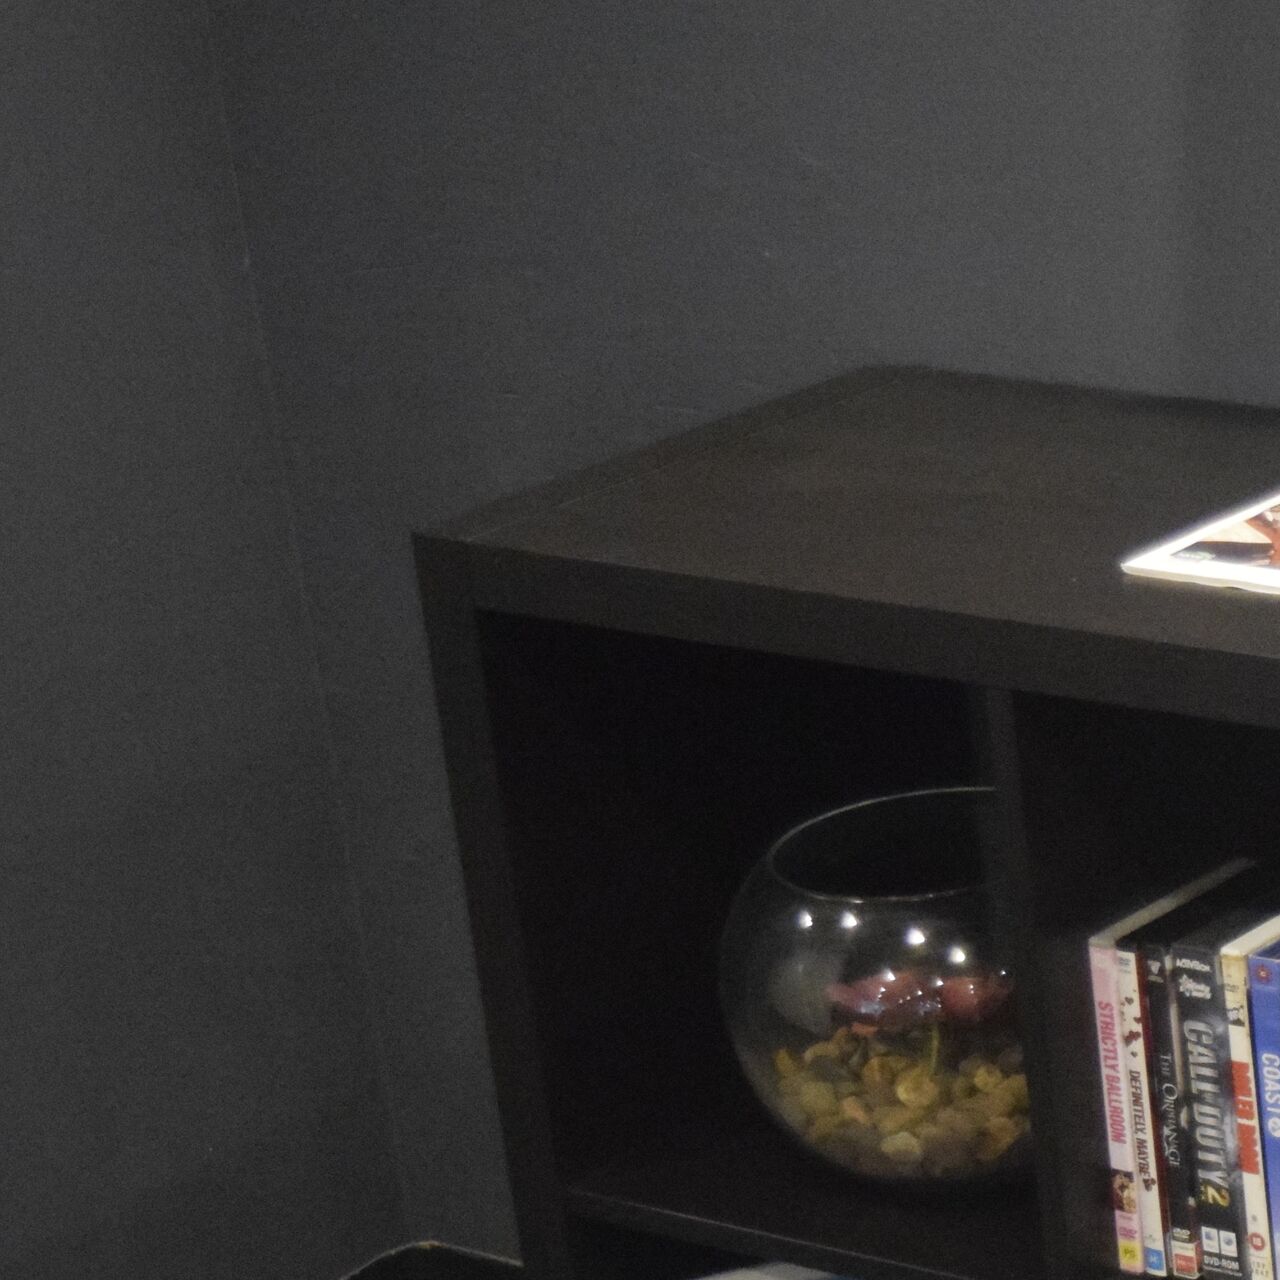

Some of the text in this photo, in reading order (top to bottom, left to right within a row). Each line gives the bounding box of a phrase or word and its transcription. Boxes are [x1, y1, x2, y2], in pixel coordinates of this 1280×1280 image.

[1097, 1001, 1127, 1146] STRICTLY BALLROOM
[1160, 1053, 1173, 1077] THE
[1183, 1019, 1221, 1095] CALL
[1128, 1069, 1151, 1179] DEFINITELY, MAYBE
[1193, 1102, 1230, 1188] DUTY
[1205, 1182, 1232, 1209] 2
[1203, 1254, 1240, 1271] DVD-ROM
